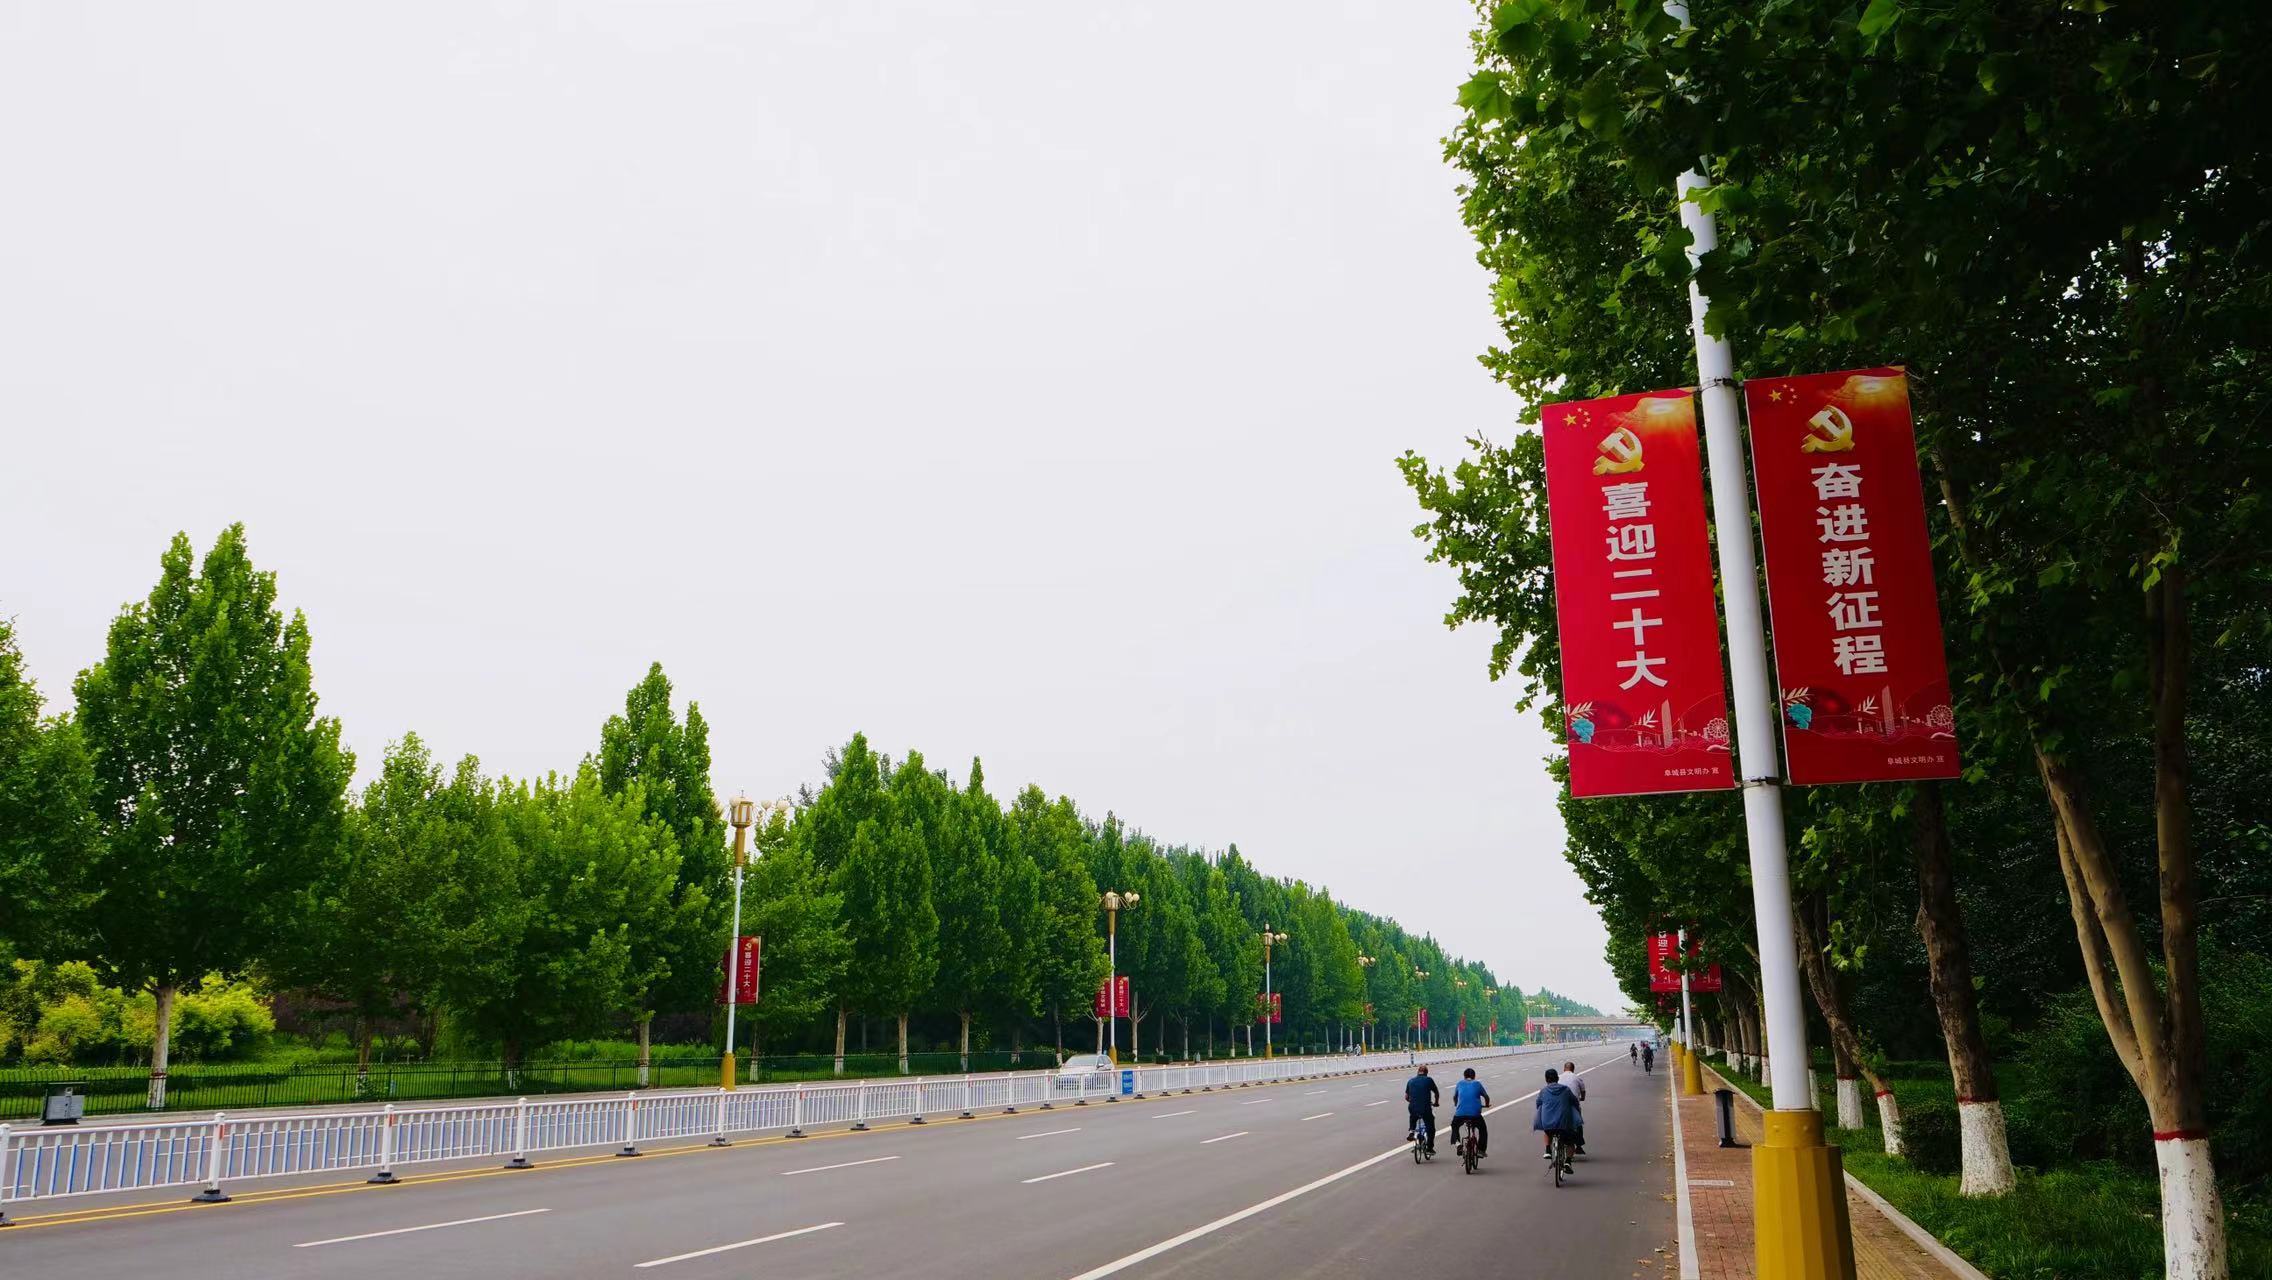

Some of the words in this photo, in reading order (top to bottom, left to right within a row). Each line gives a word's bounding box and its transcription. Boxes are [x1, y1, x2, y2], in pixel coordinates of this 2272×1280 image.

[1601, 481, 1668, 690] 喜迎二十大
[1811, 462, 1888, 675] 奋进新征程
